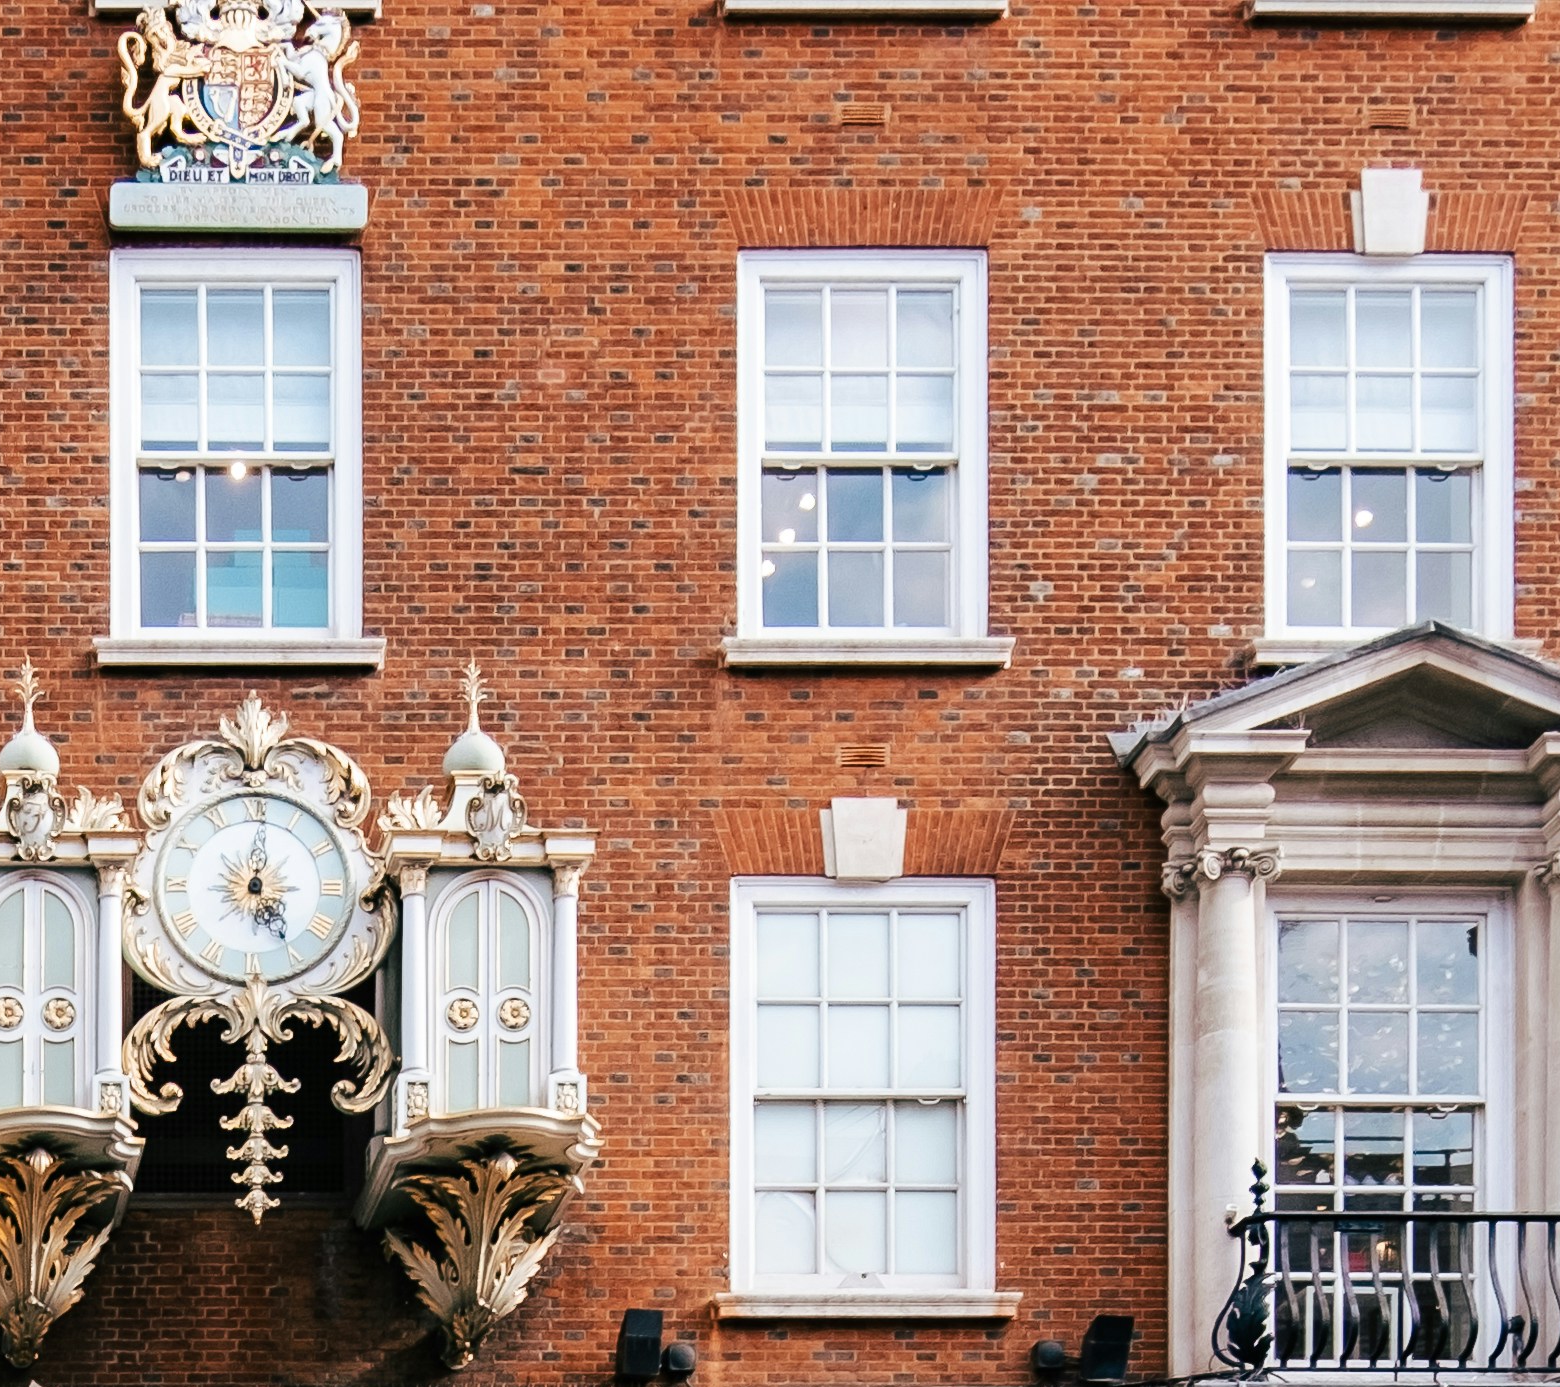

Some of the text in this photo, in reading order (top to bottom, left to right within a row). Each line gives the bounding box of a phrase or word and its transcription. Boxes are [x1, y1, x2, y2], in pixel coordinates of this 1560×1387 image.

[169, 169, 310, 182] DIEU ET MON DROIT
